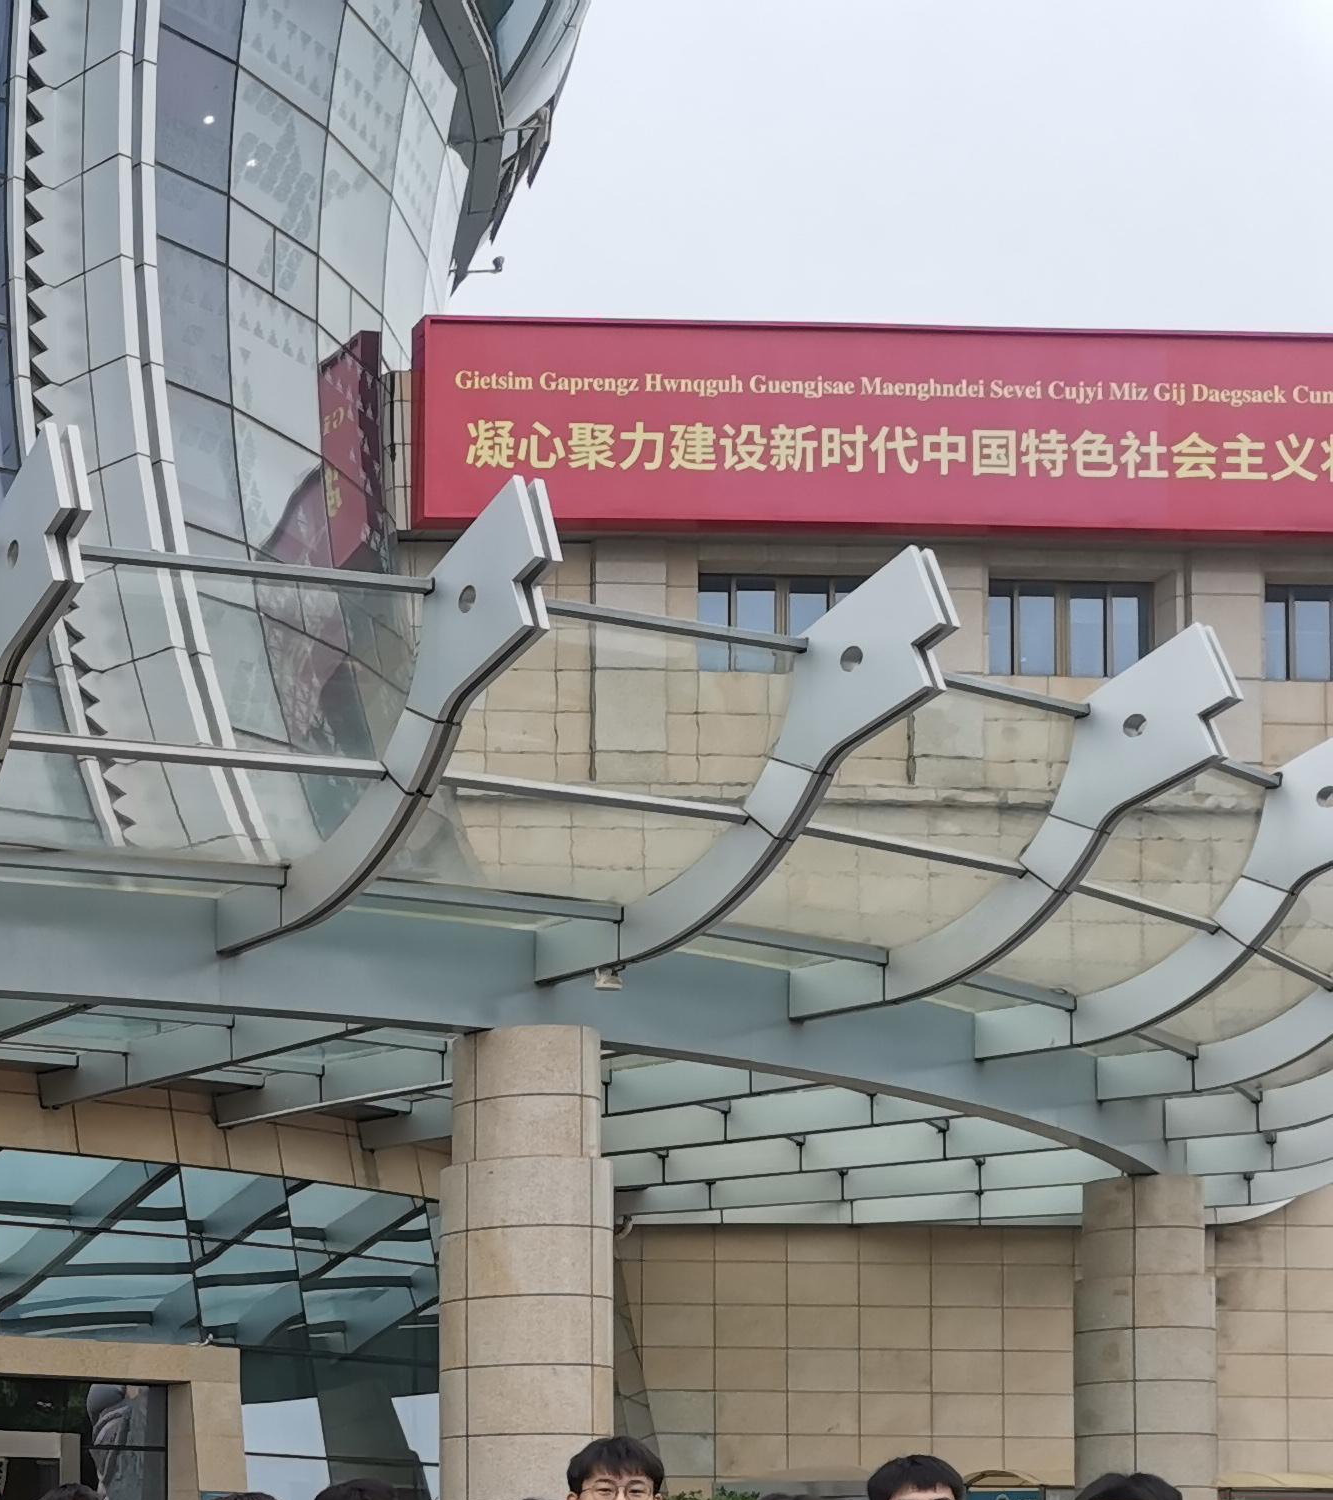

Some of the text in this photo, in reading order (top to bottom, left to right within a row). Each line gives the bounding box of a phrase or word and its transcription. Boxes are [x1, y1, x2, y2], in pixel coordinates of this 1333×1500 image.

[454, 370, 533, 391] Gietsim
[539, 371, 639, 396] Gaprengz
[645, 373, 744, 398] Hwnqguh
[749, 374, 855, 399] Guengjsae
[990, 379, 1042, 400] Sevei
[1048, 381, 1103, 405] Cujyi
[1109, 382, 1149, 401] Miz
[1153, 382, 1186, 406] Gij
[1192, 383, 1286, 408] Daegsaek
